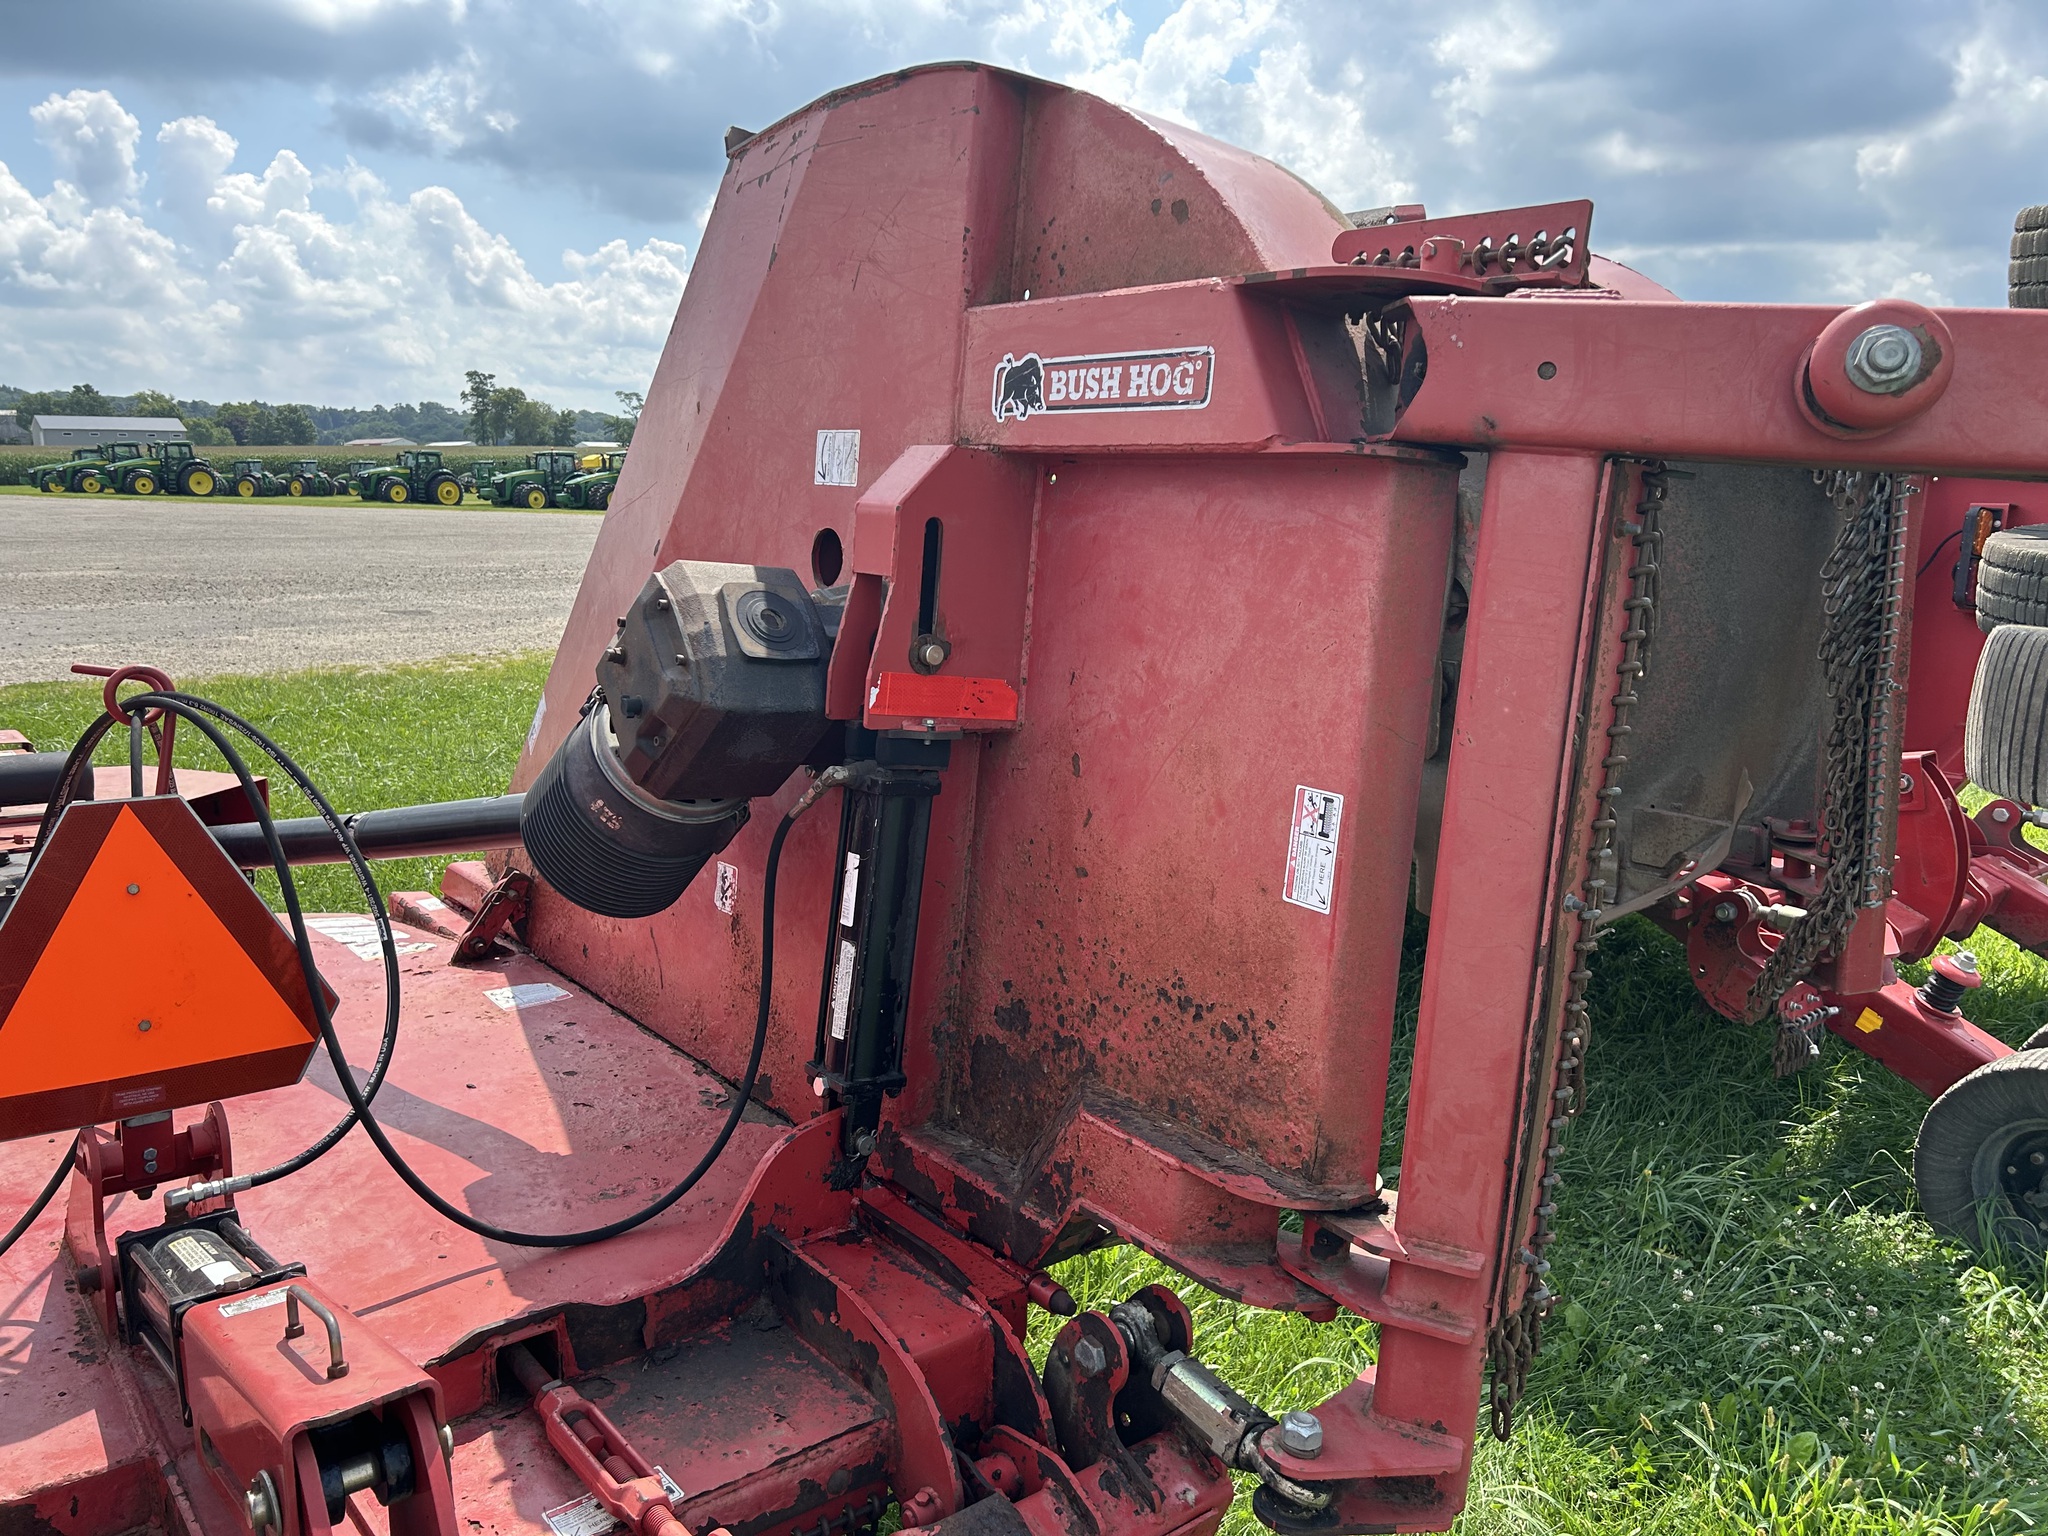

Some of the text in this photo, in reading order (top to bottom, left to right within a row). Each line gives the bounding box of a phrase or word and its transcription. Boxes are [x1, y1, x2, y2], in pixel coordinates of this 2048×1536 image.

[1049, 366, 1123, 401] BUSH
[325, 816, 336, 830] MPa
[342, 843, 350, 854] WP
[1292, 826, 1300, 857] DANGER
[349, 854, 367, 888] Worldwide
[1319, 863, 1327, 885] HERE
[369, 1062, 382, 1083] MADE
[381, 1037, 389, 1052] USA
[588, 1514, 613, 1529] HERE
